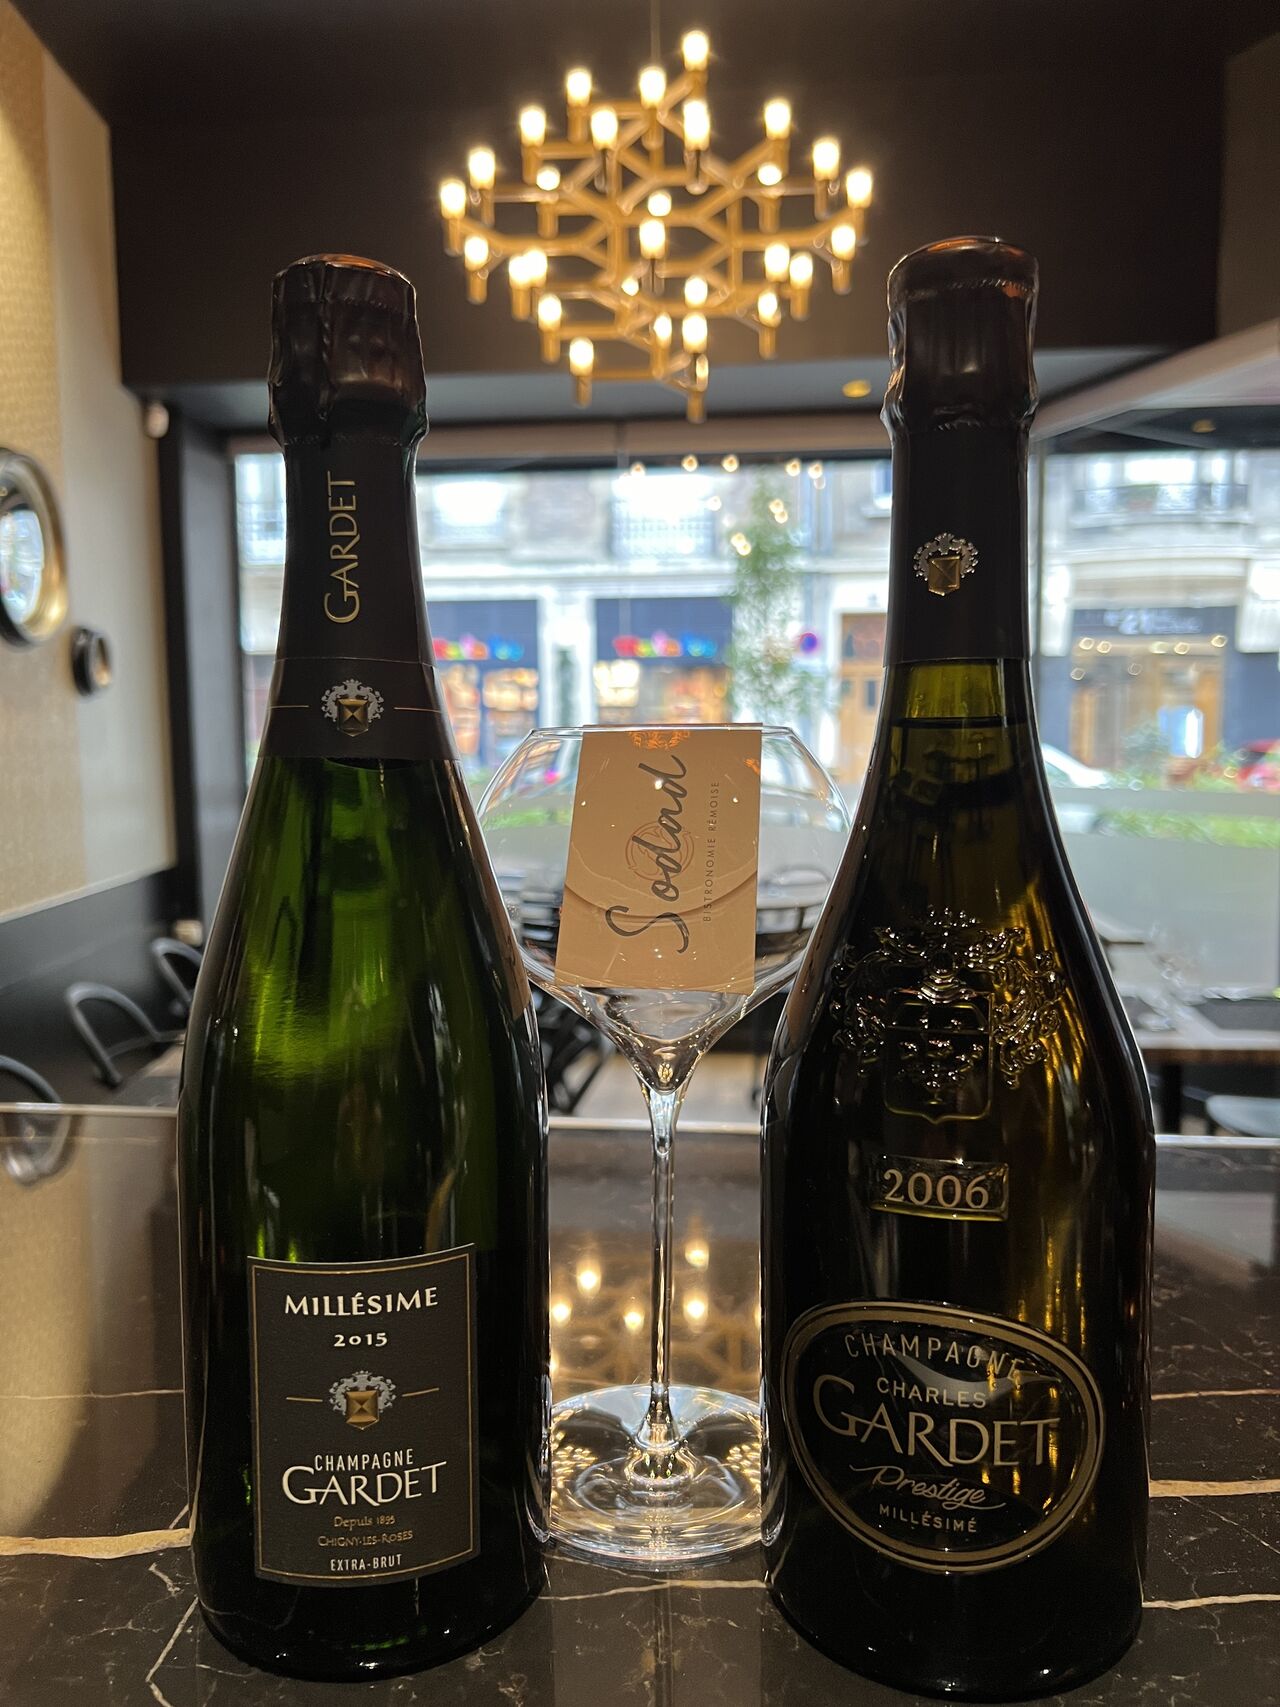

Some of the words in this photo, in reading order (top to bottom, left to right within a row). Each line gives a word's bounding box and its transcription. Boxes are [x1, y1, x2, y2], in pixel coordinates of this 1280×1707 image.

[323, 470, 361, 624] GARDET
[708, 781, 720, 832] RÉMOISE
[702, 837, 717, 922] BISTRONOMIE
[883, 1168, 989, 1209] 2006
[284, 1286, 439, 1317] MILLÉSIME
[333, 1331, 389, 1348] 2015
[844, 1332, 1025, 1382] CHAMPAGNE
[876, 1376, 987, 1409] CHARLES
[812, 1374, 1062, 1468] GARDET
[314, 1448, 414, 1473] CHAMPAGNE
[281, 1460, 448, 1507] GARDET
[848, 1463, 1007, 1511] Prestige
[333, 1515, 373, 1531] Depuis
[879, 1502, 978, 1534] MILLÉSIMÉ
[330, 1553, 403, 1572] EXTRA-BRUT
